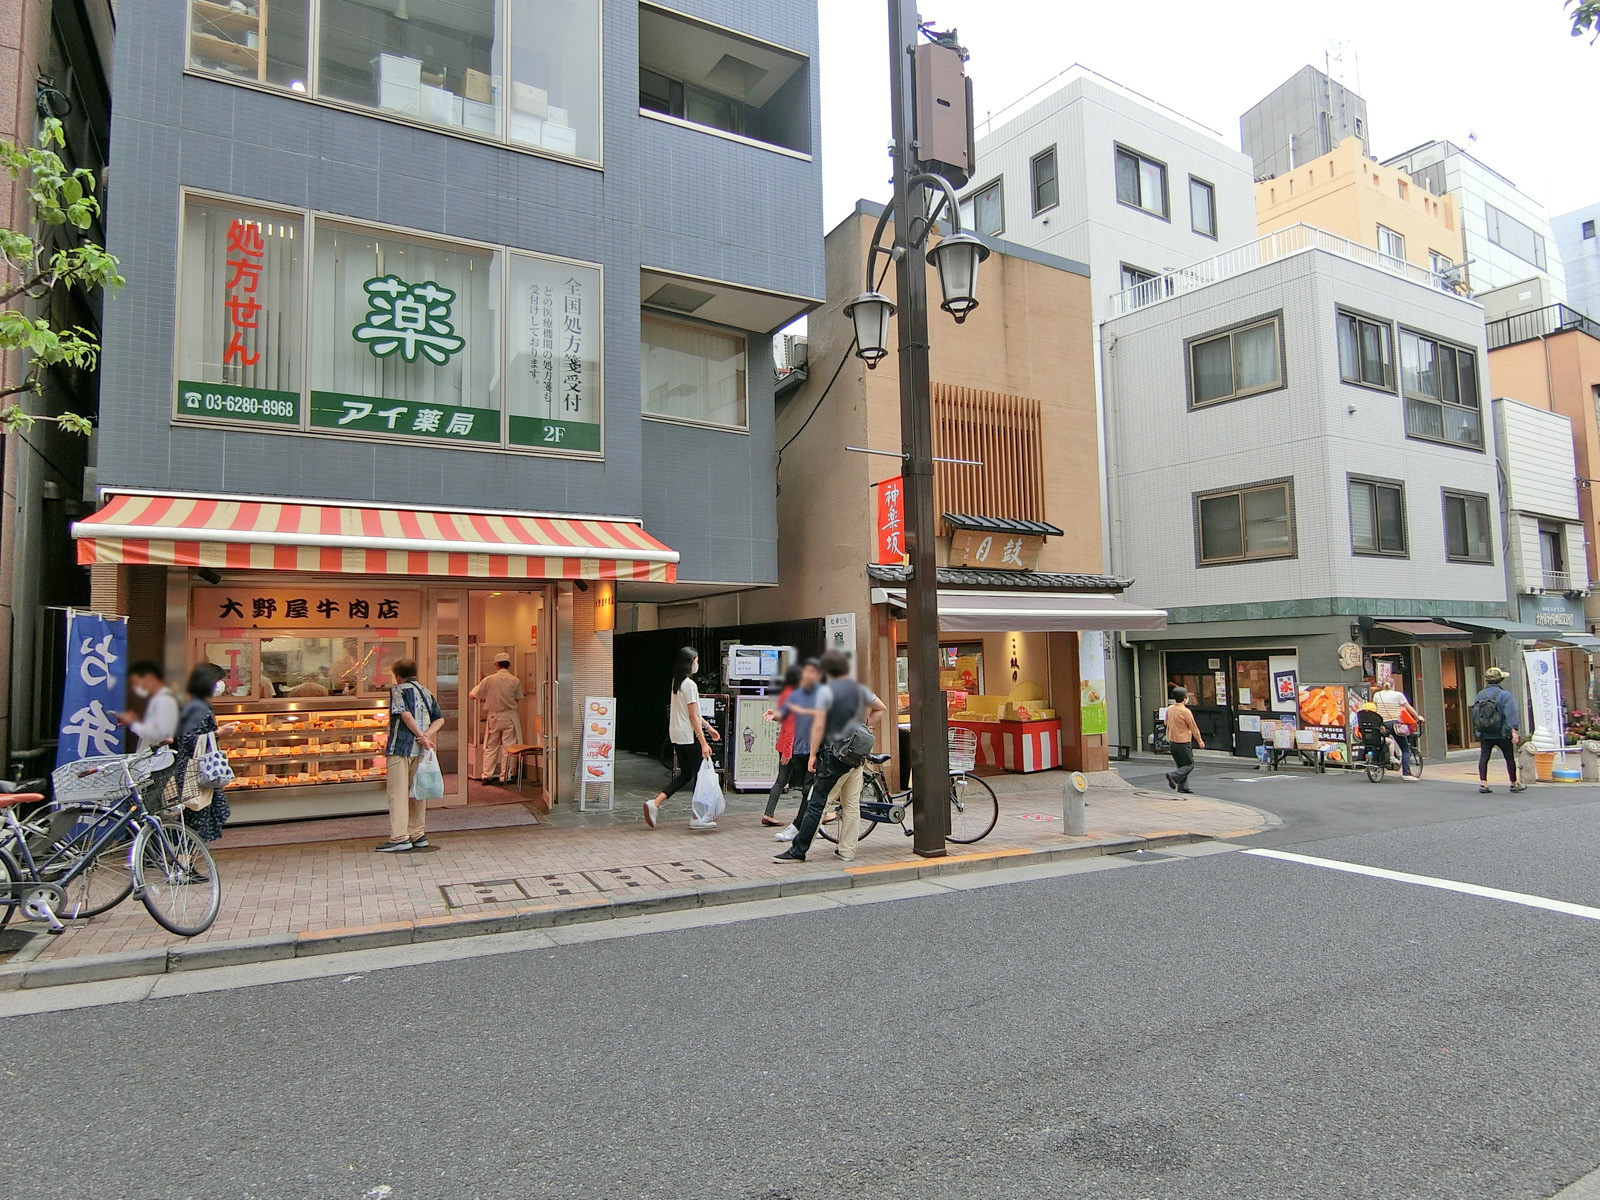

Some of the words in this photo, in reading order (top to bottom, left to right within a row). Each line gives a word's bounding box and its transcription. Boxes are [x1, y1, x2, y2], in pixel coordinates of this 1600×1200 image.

[224, 218, 265, 366] 処方せん
[355, 275, 464, 364] 薬
[563, 277, 582, 412] 全国処方箋受付
[206, 393, 293, 417] 03-6280-8968
[338, 401, 475, 435] アイ薬局
[543, 425, 566, 442] 2F
[882, 483, 905, 556] 神楽坂
[218, 596, 401, 620] 大野屋牛肉店
